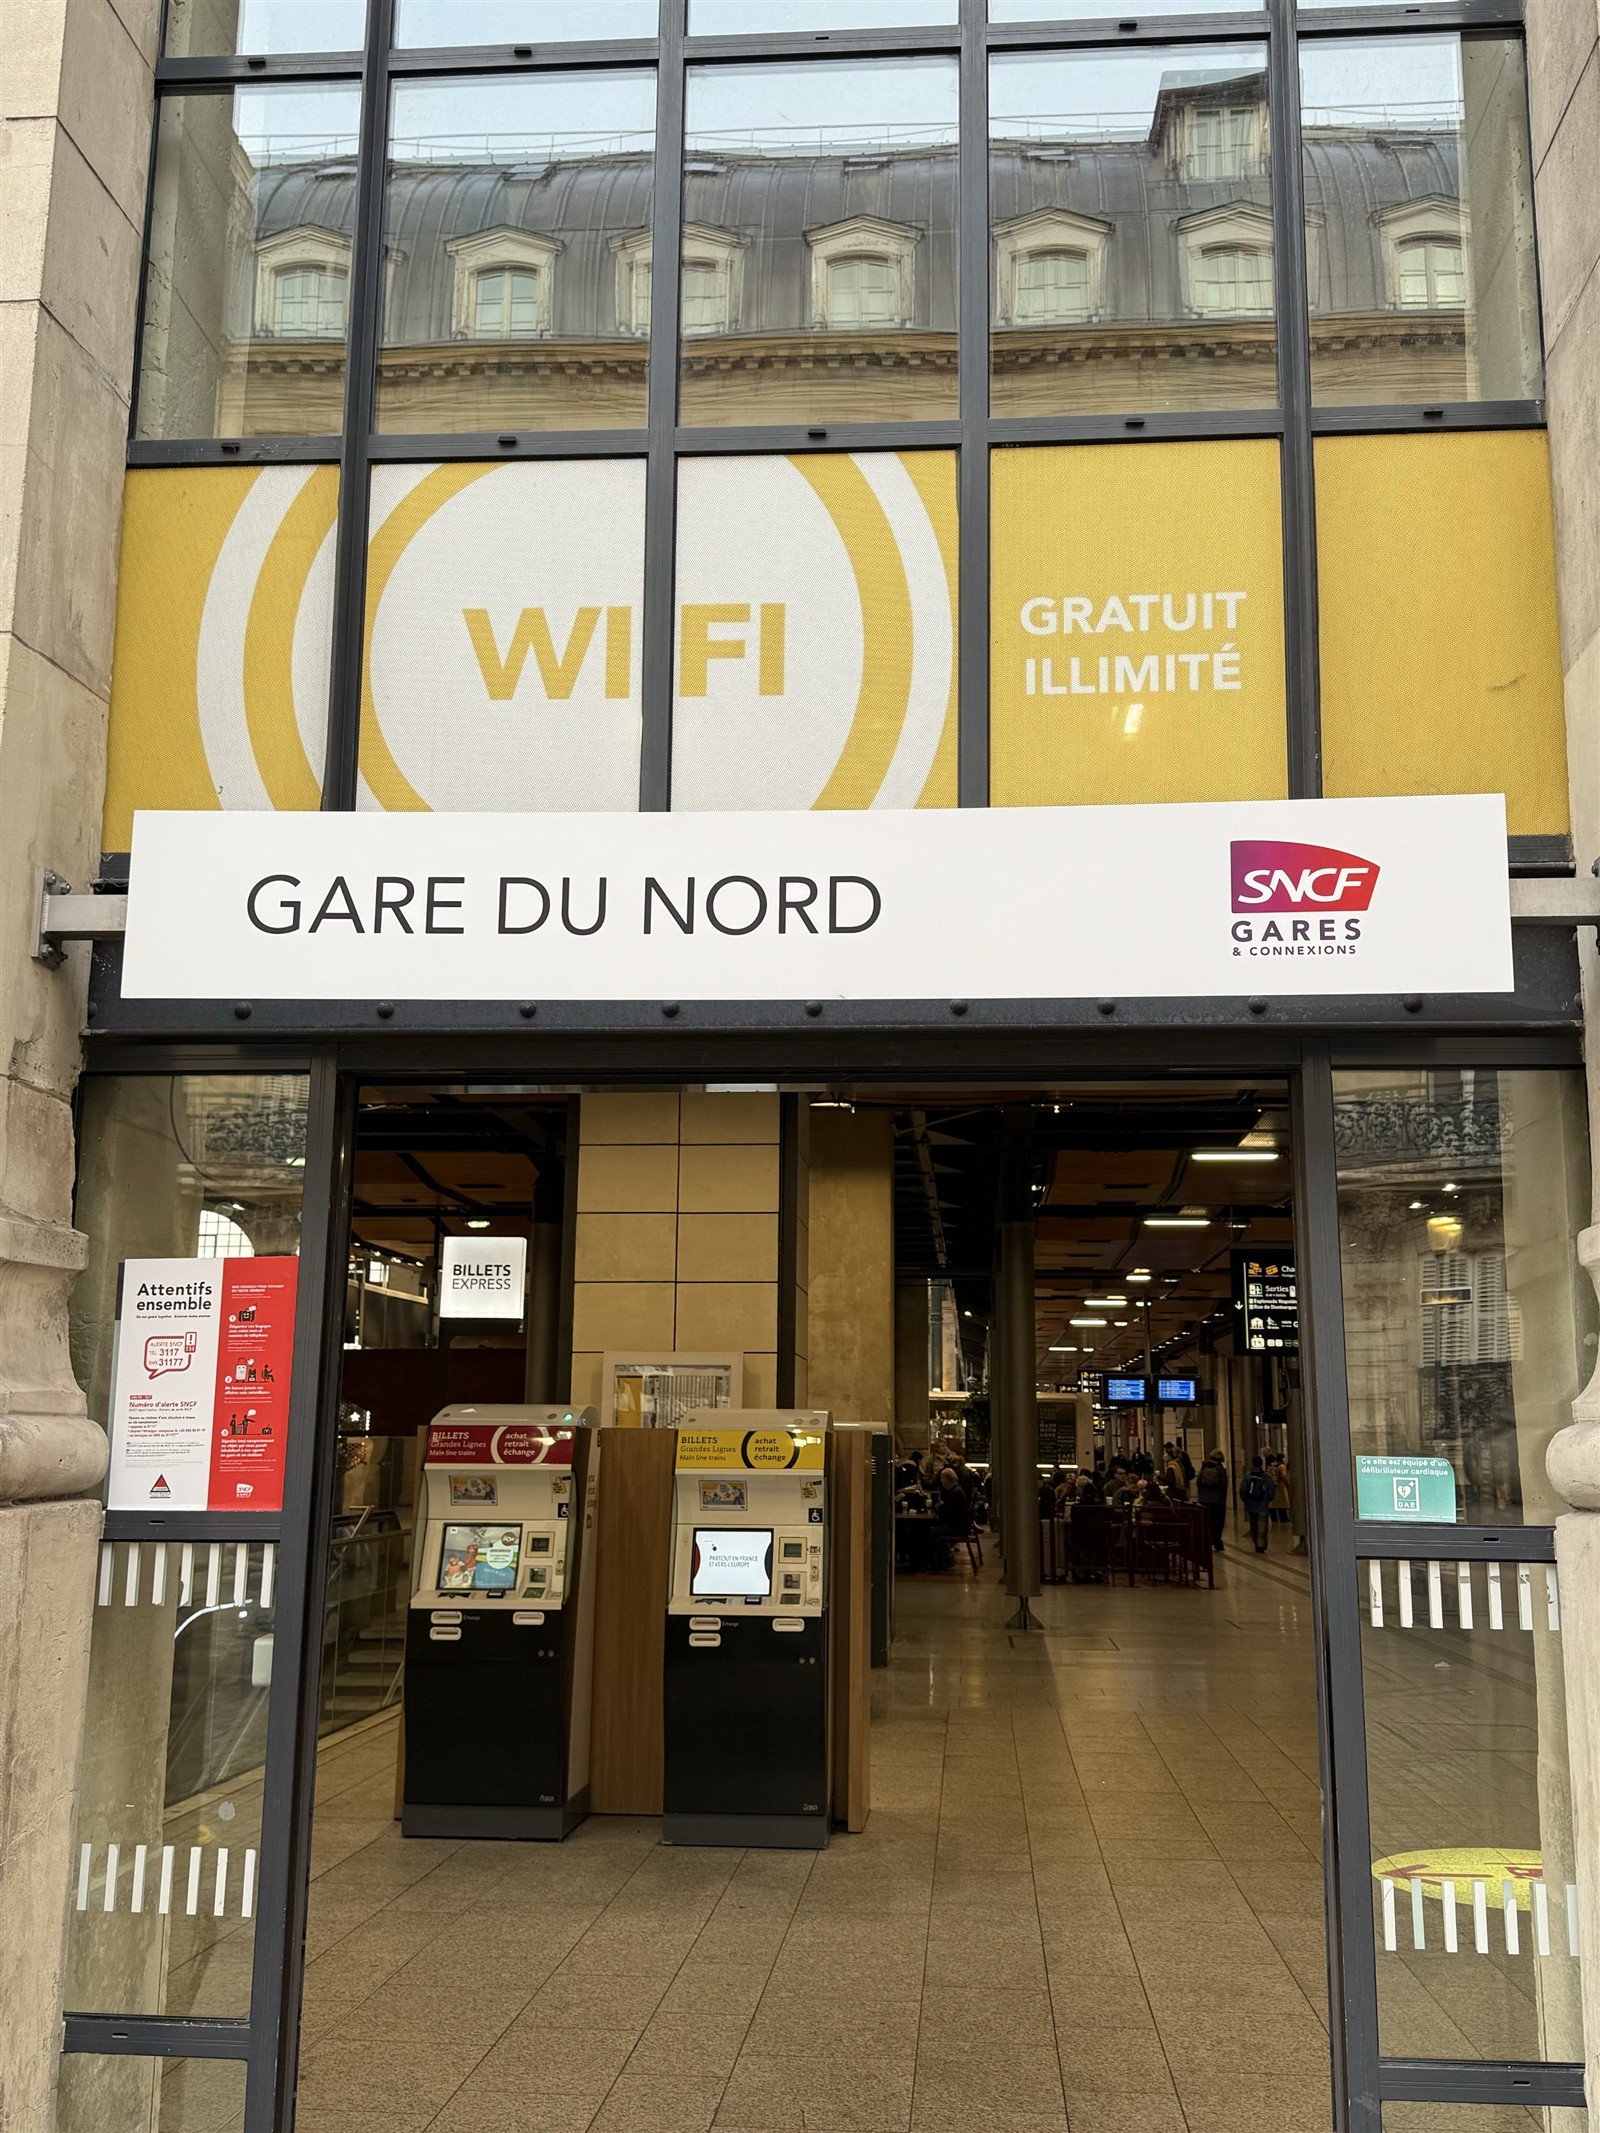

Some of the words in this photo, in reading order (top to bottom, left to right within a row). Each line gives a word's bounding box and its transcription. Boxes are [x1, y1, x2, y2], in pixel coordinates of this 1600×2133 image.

[1020, 591, 1247, 636] GRATUIT
[1025, 642, 1243, 695] ILLIMITÉ
[1237, 866, 1370, 905] SNCF
[246, 873, 466, 935] GARE
[497, 876, 608, 936] DU
[643, 874, 883, 936] NORD
[1230, 918, 1362, 943] GARES
[1232, 947, 1242, 957] &
[1249, 945, 1357, 957] CONNEXIONS
[452, 1264, 511, 1277] BILLETS
[136, 1281, 213, 1296] Attentifs
[452, 1278, 511, 1290] EXPRESS
[136, 1296, 212, 1311] ensemble
[159, 1348, 179, 1357] 3117
[159, 1358, 183, 1366] 31177
[432, 1431, 470, 1440] BILLETS
[505, 1432, 527, 1440] achat
[681, 1436, 718, 1444] BILLETS
[430, 1440, 461, 1448] Grandes
[462, 1440, 486, 1449] Lignes
[504, 1440, 529, 1448] retrait
[754, 1437, 777, 1445] achat
[503, 1449, 535, 1457] échange
[680, 1445, 711, 1453] Grandes
[712, 1446, 736, 1454] Lignes
[754, 1454, 786, 1462] échange
[1402, 1458, 1427, 1467] équipé
[1361, 1466, 1409, 1475] défibrillateur
[1411, 1468, 1448, 1477] cardiaque
